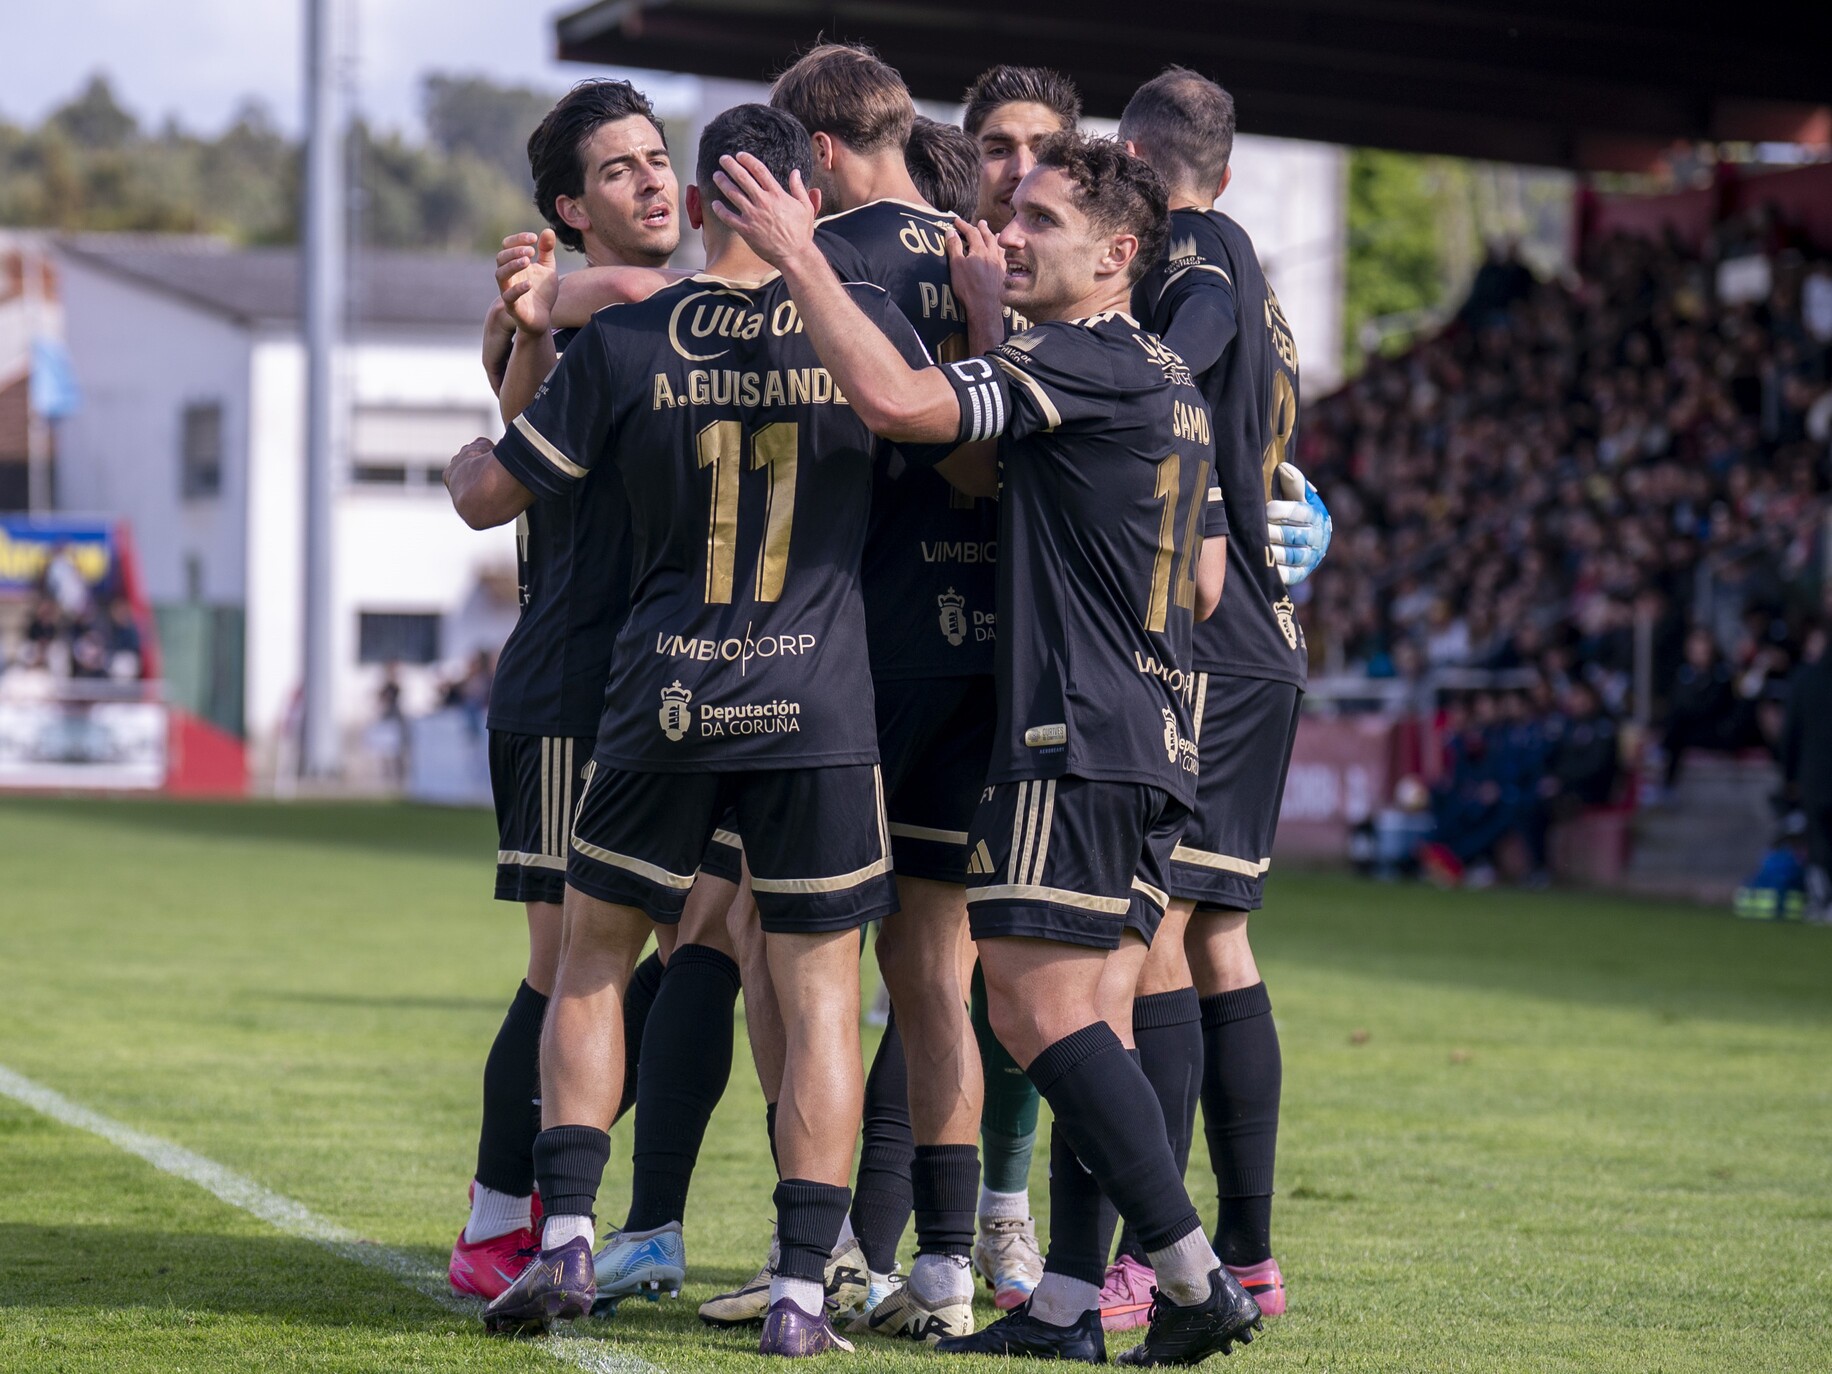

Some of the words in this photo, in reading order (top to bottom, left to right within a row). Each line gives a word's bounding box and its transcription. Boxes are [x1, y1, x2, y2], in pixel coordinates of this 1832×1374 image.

[918, 281, 968, 324] PA
[690, 304, 764, 341] Ulla
[696, 419, 799, 604] 11
[701, 700, 800, 722] Deputación
[701, 721, 725, 737] DA
[729, 717, 800, 736] CORUÑA
